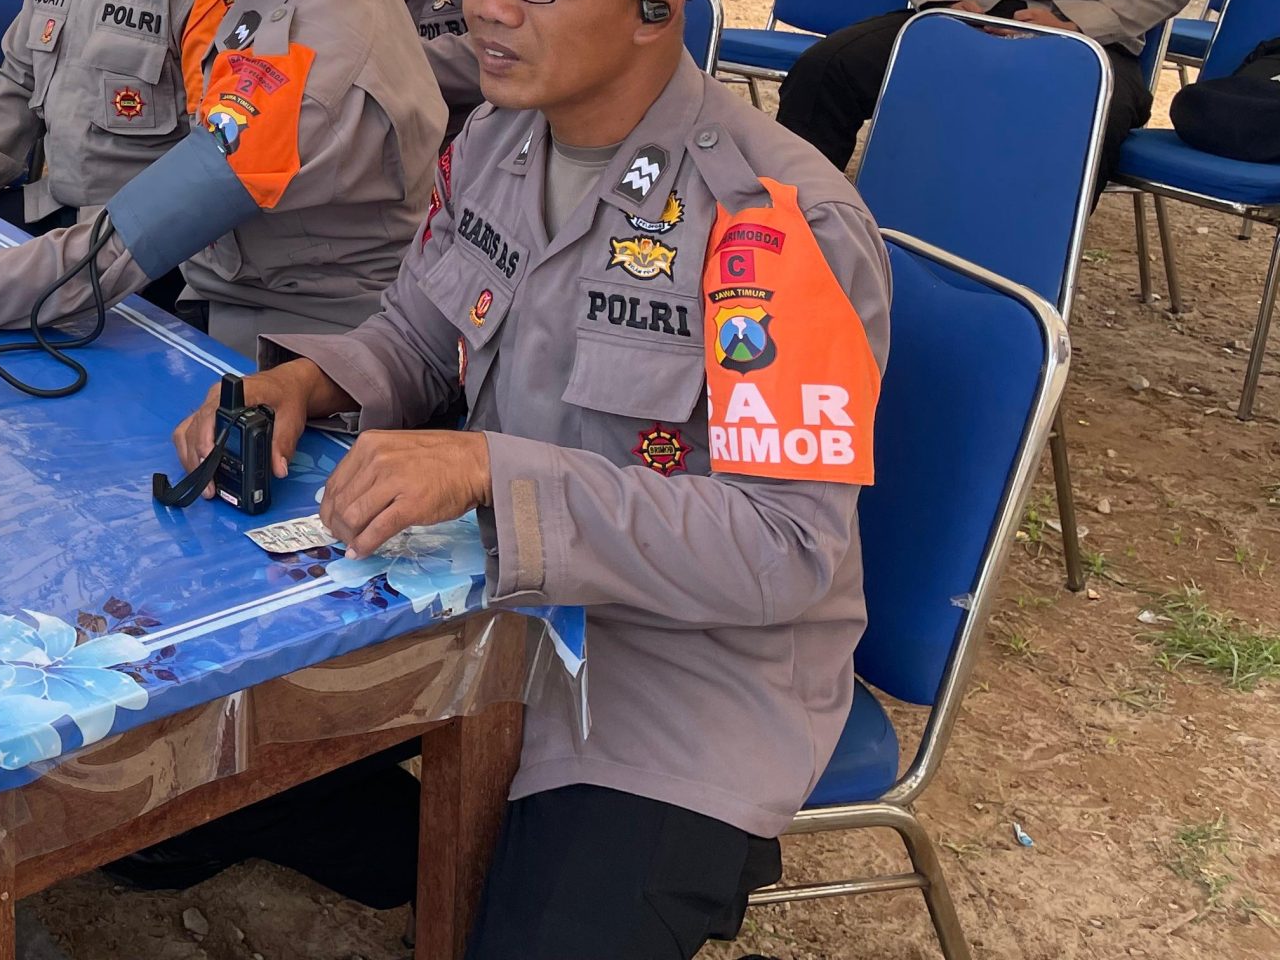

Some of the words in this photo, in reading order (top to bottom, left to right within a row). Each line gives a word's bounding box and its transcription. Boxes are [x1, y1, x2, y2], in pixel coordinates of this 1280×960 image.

[102, 3, 162, 35] POLRI
[240, 79, 252, 93] 2
[237, 97, 256, 113] TIMUR
[727, 255, 746, 277] C
[714, 289, 736, 300] JAWA
[736, 288, 766, 299] TIMUR
[587, 291, 691, 337] POLRI
[709, 426, 855, 465] RIMOB
